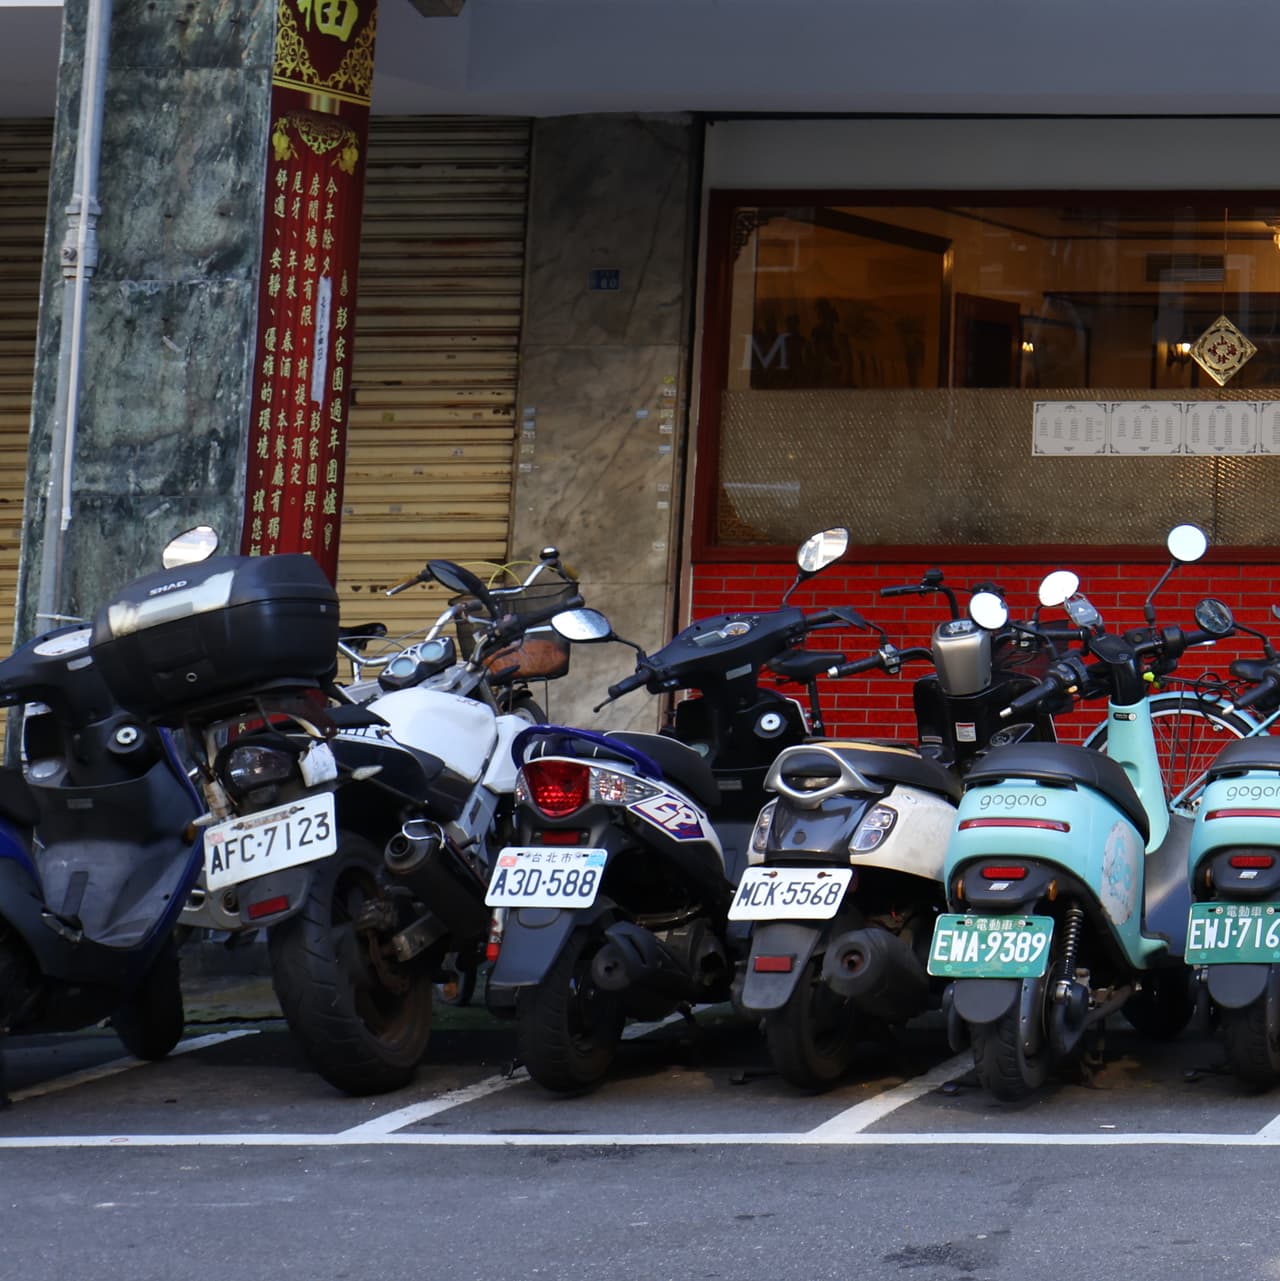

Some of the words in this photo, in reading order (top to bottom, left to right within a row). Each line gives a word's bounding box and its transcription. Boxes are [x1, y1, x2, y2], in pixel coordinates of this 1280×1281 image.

[320, 175, 338, 277] 今年除夕
[980, 792, 1048, 810] gogoro
[531, 851, 574, 864] 台北市
